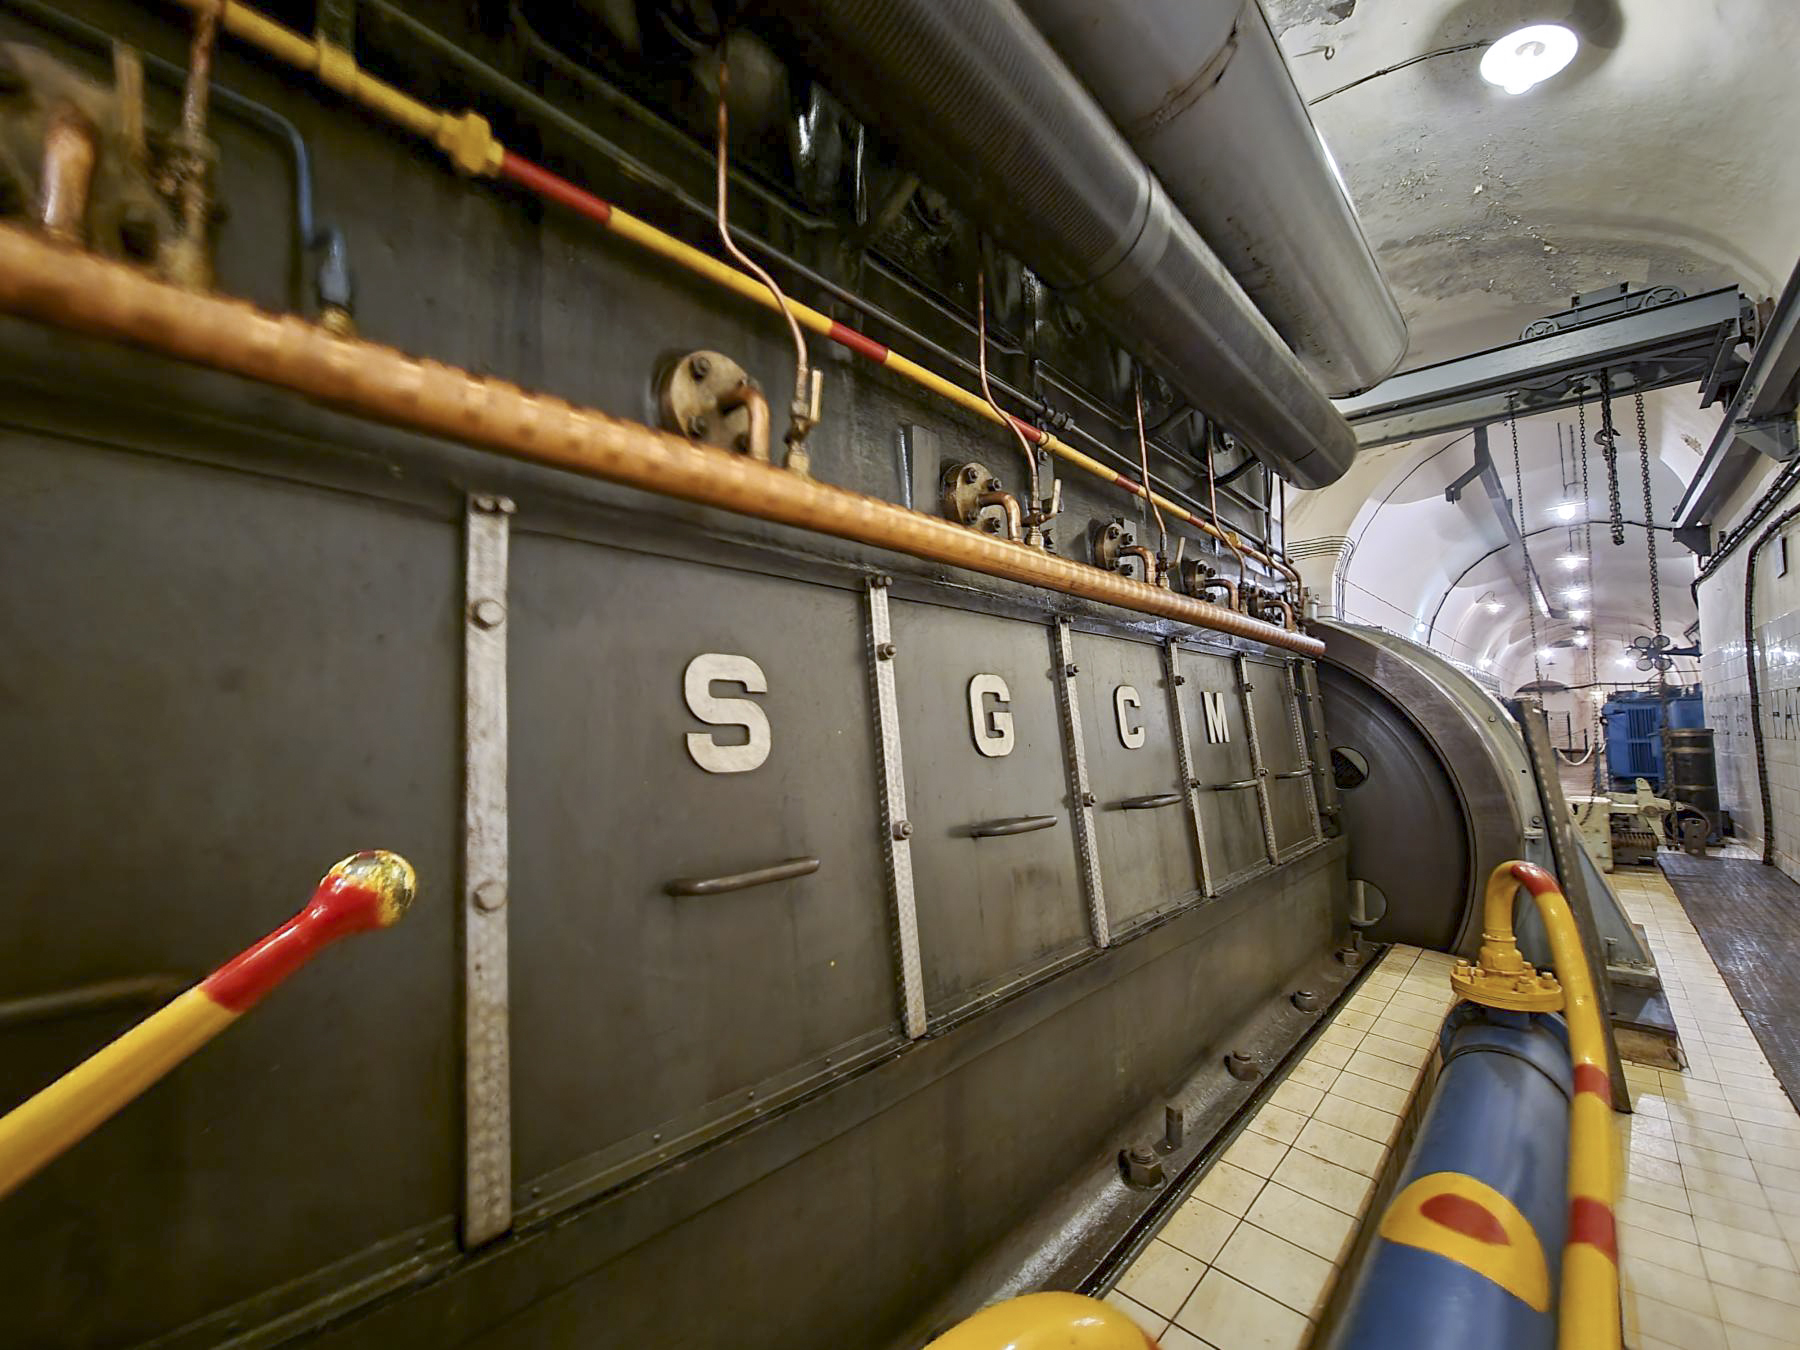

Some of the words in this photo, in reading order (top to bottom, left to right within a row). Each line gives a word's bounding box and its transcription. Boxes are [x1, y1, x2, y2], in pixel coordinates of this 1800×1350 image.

[683, 653, 771, 773] S
[967, 673, 1015, 757] G
[1114, 685, 1145, 749] C
[1202, 691, 1231, 744] M
